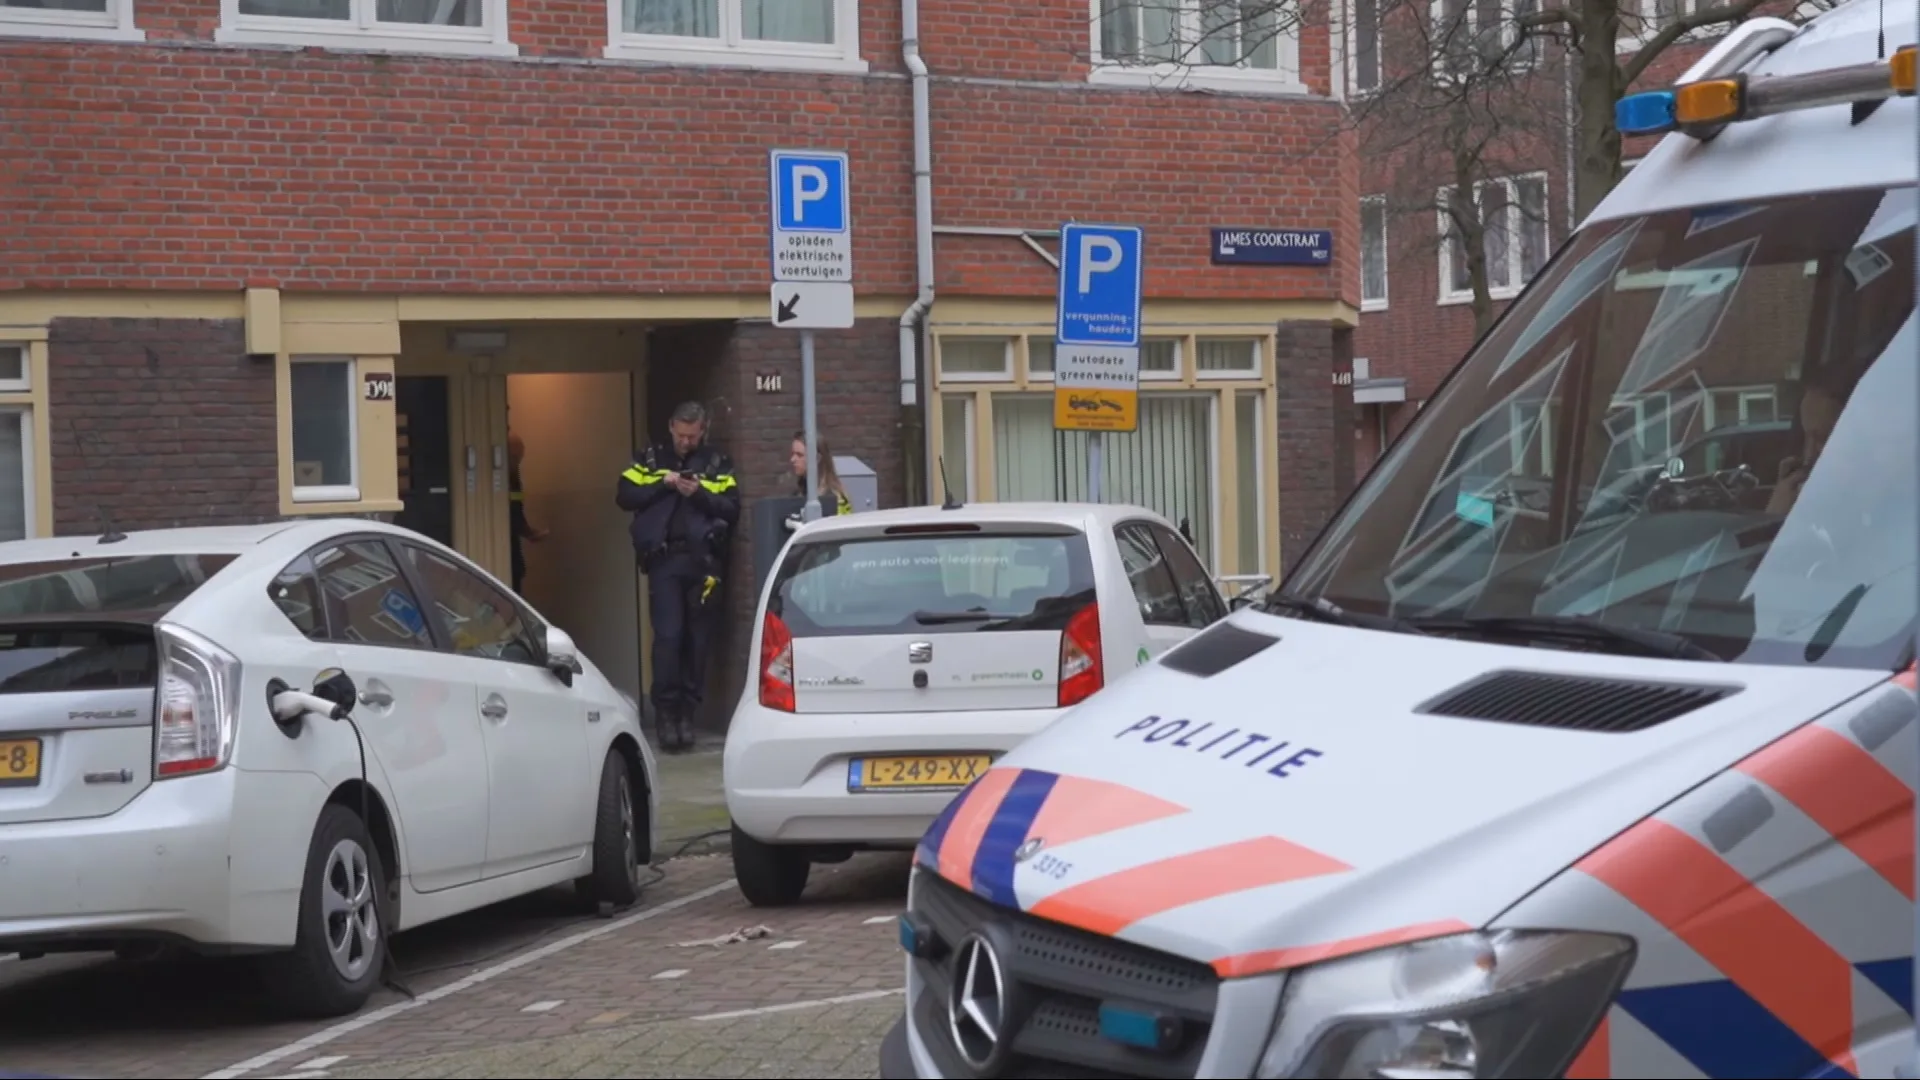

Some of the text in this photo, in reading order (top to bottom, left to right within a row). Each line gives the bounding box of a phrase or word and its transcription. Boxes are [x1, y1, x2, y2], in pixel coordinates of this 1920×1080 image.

[792, 165, 828, 222] P
[789, 235, 833, 247] opladen
[1254, 232, 1320, 247] COOKSTRAAT
[779, 249, 844, 260] elektrische
[1079, 234, 1123, 294] P
[781, 266, 843, 279] voertuigen
[1088, 324, 1132, 335] houders
[1072, 355, 1124, 365] autodate
[1060, 371, 1135, 382] greenwheels
[880, 554, 910, 567] auto
[914, 553, 943, 565] voor
[1114, 715, 1323, 778] POLITIE
[870, 758, 977, 782] L-249-XX
[1031, 853, 1073, 880] 3315
